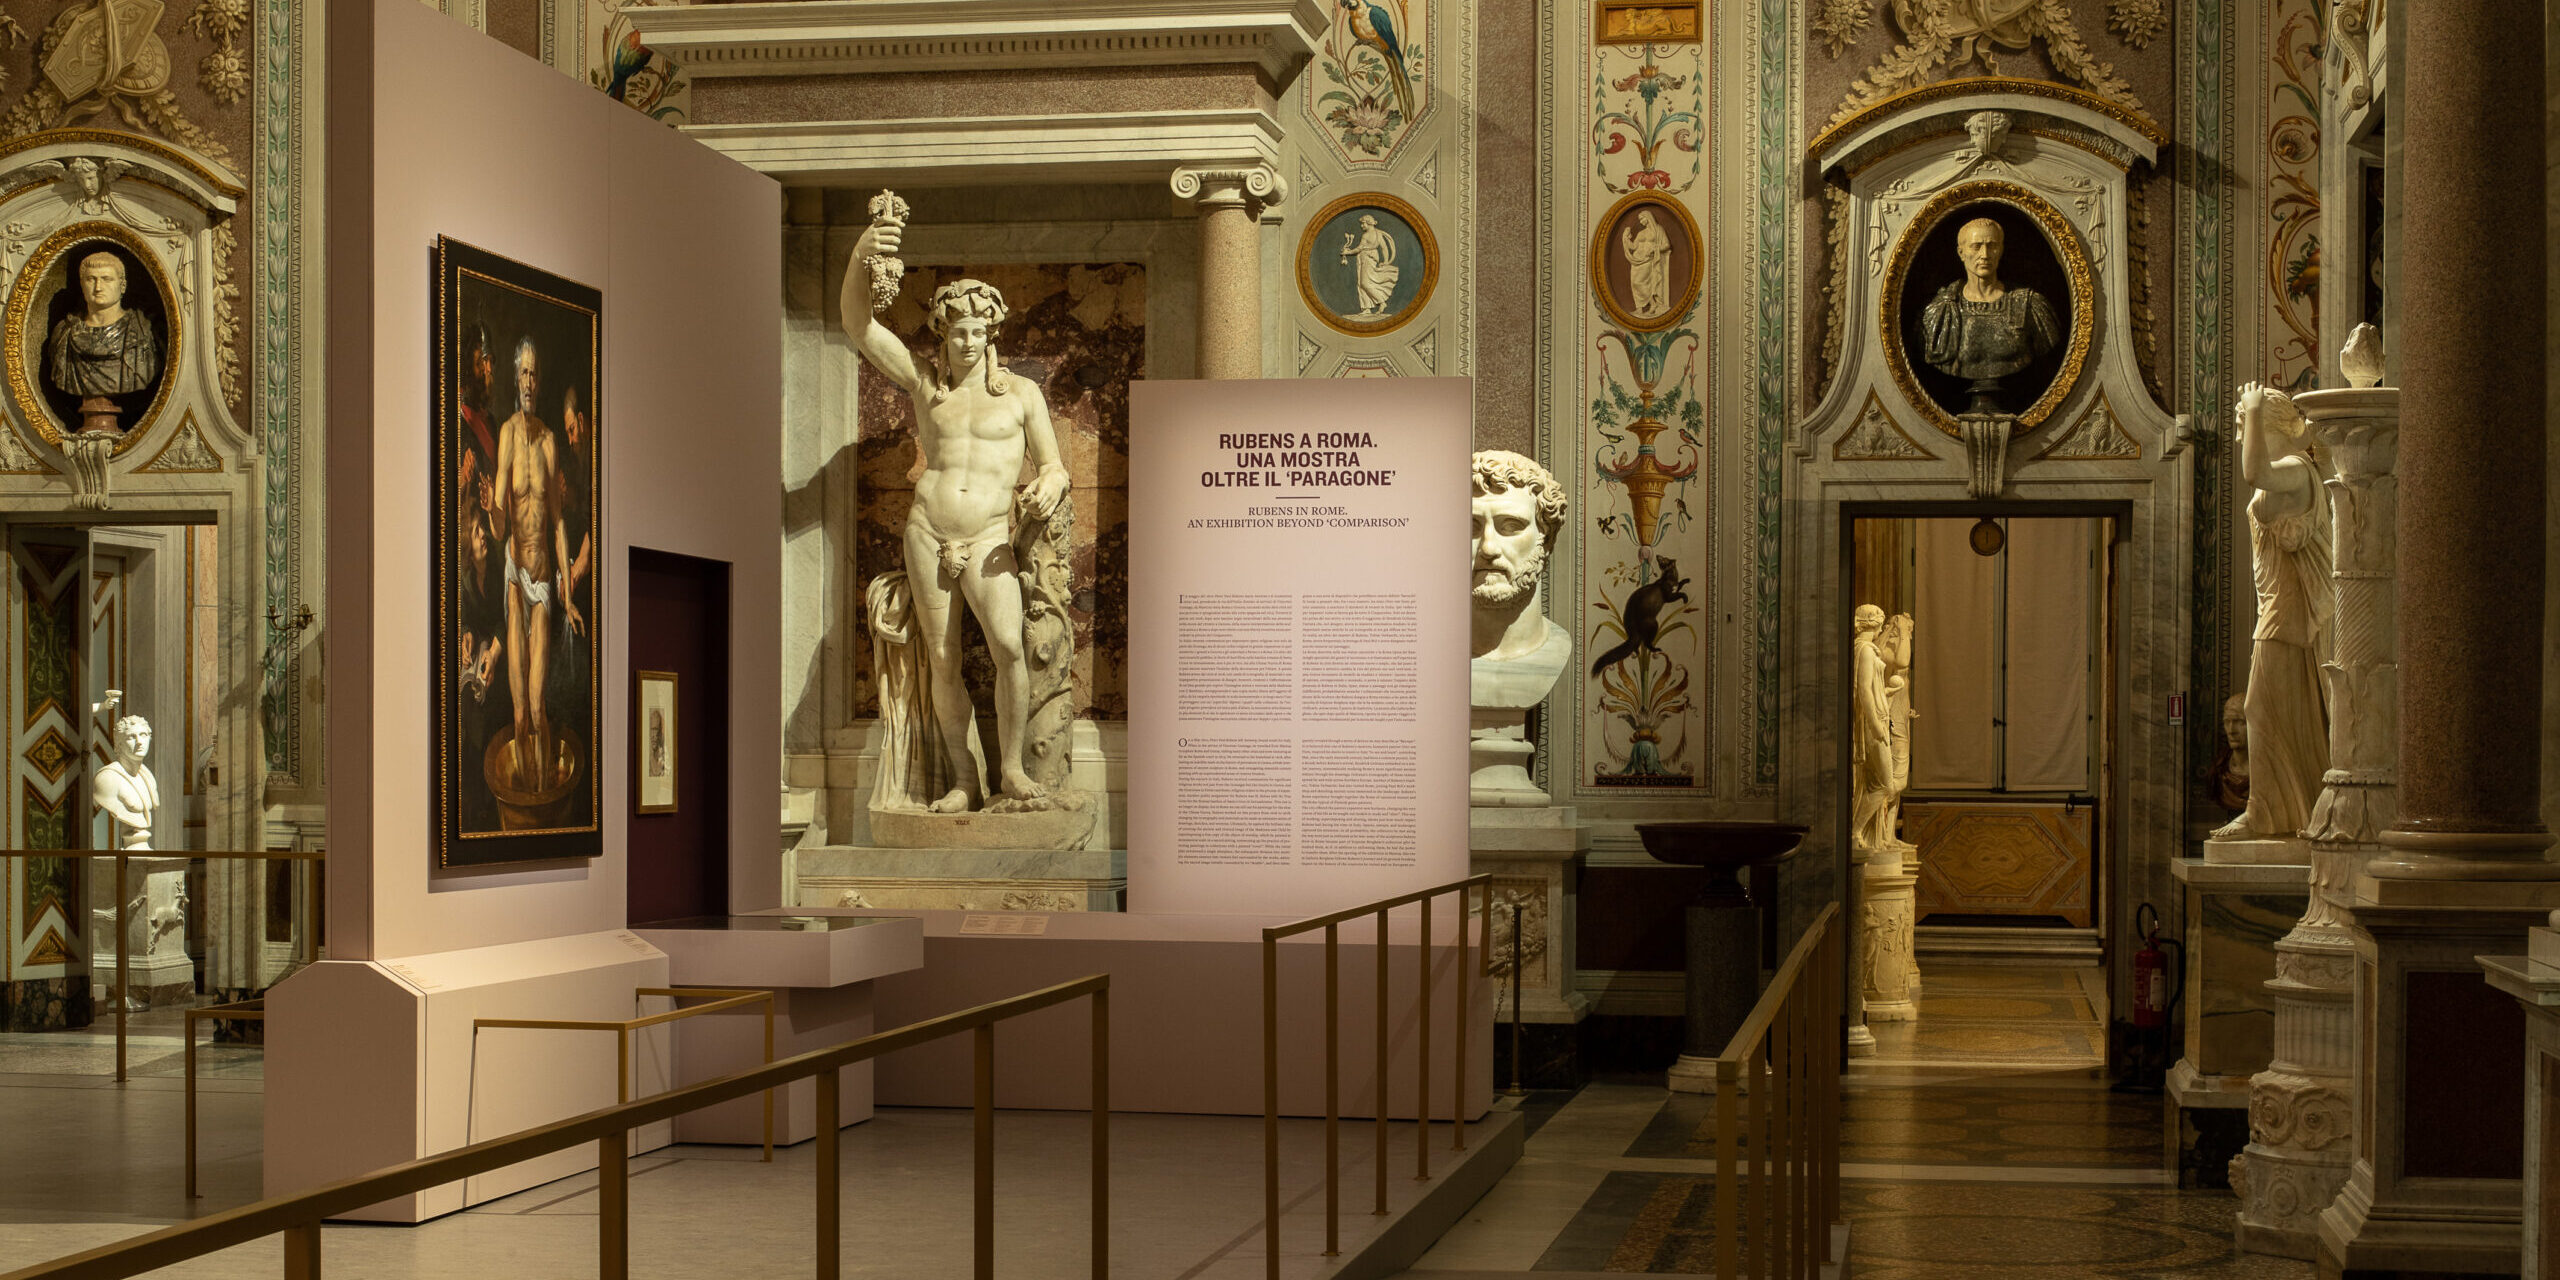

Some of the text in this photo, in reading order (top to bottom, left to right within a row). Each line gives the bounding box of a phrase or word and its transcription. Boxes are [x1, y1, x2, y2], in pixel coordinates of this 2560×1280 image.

[1219, 432, 1378, 449] RUBENS A ROMA.
[1237, 451, 1360, 468] UNA MOSTRA
[1201, 471, 1259, 487] OLTRE
[1265, 471, 1281, 486] IL
[1248, 506, 1348, 517] RUBENS IN ROME.
[1187, 518, 1204, 528] AN
[1206, 518, 1275, 528] EXHIBITION
[1277, 518, 1324, 528] BEYOND
